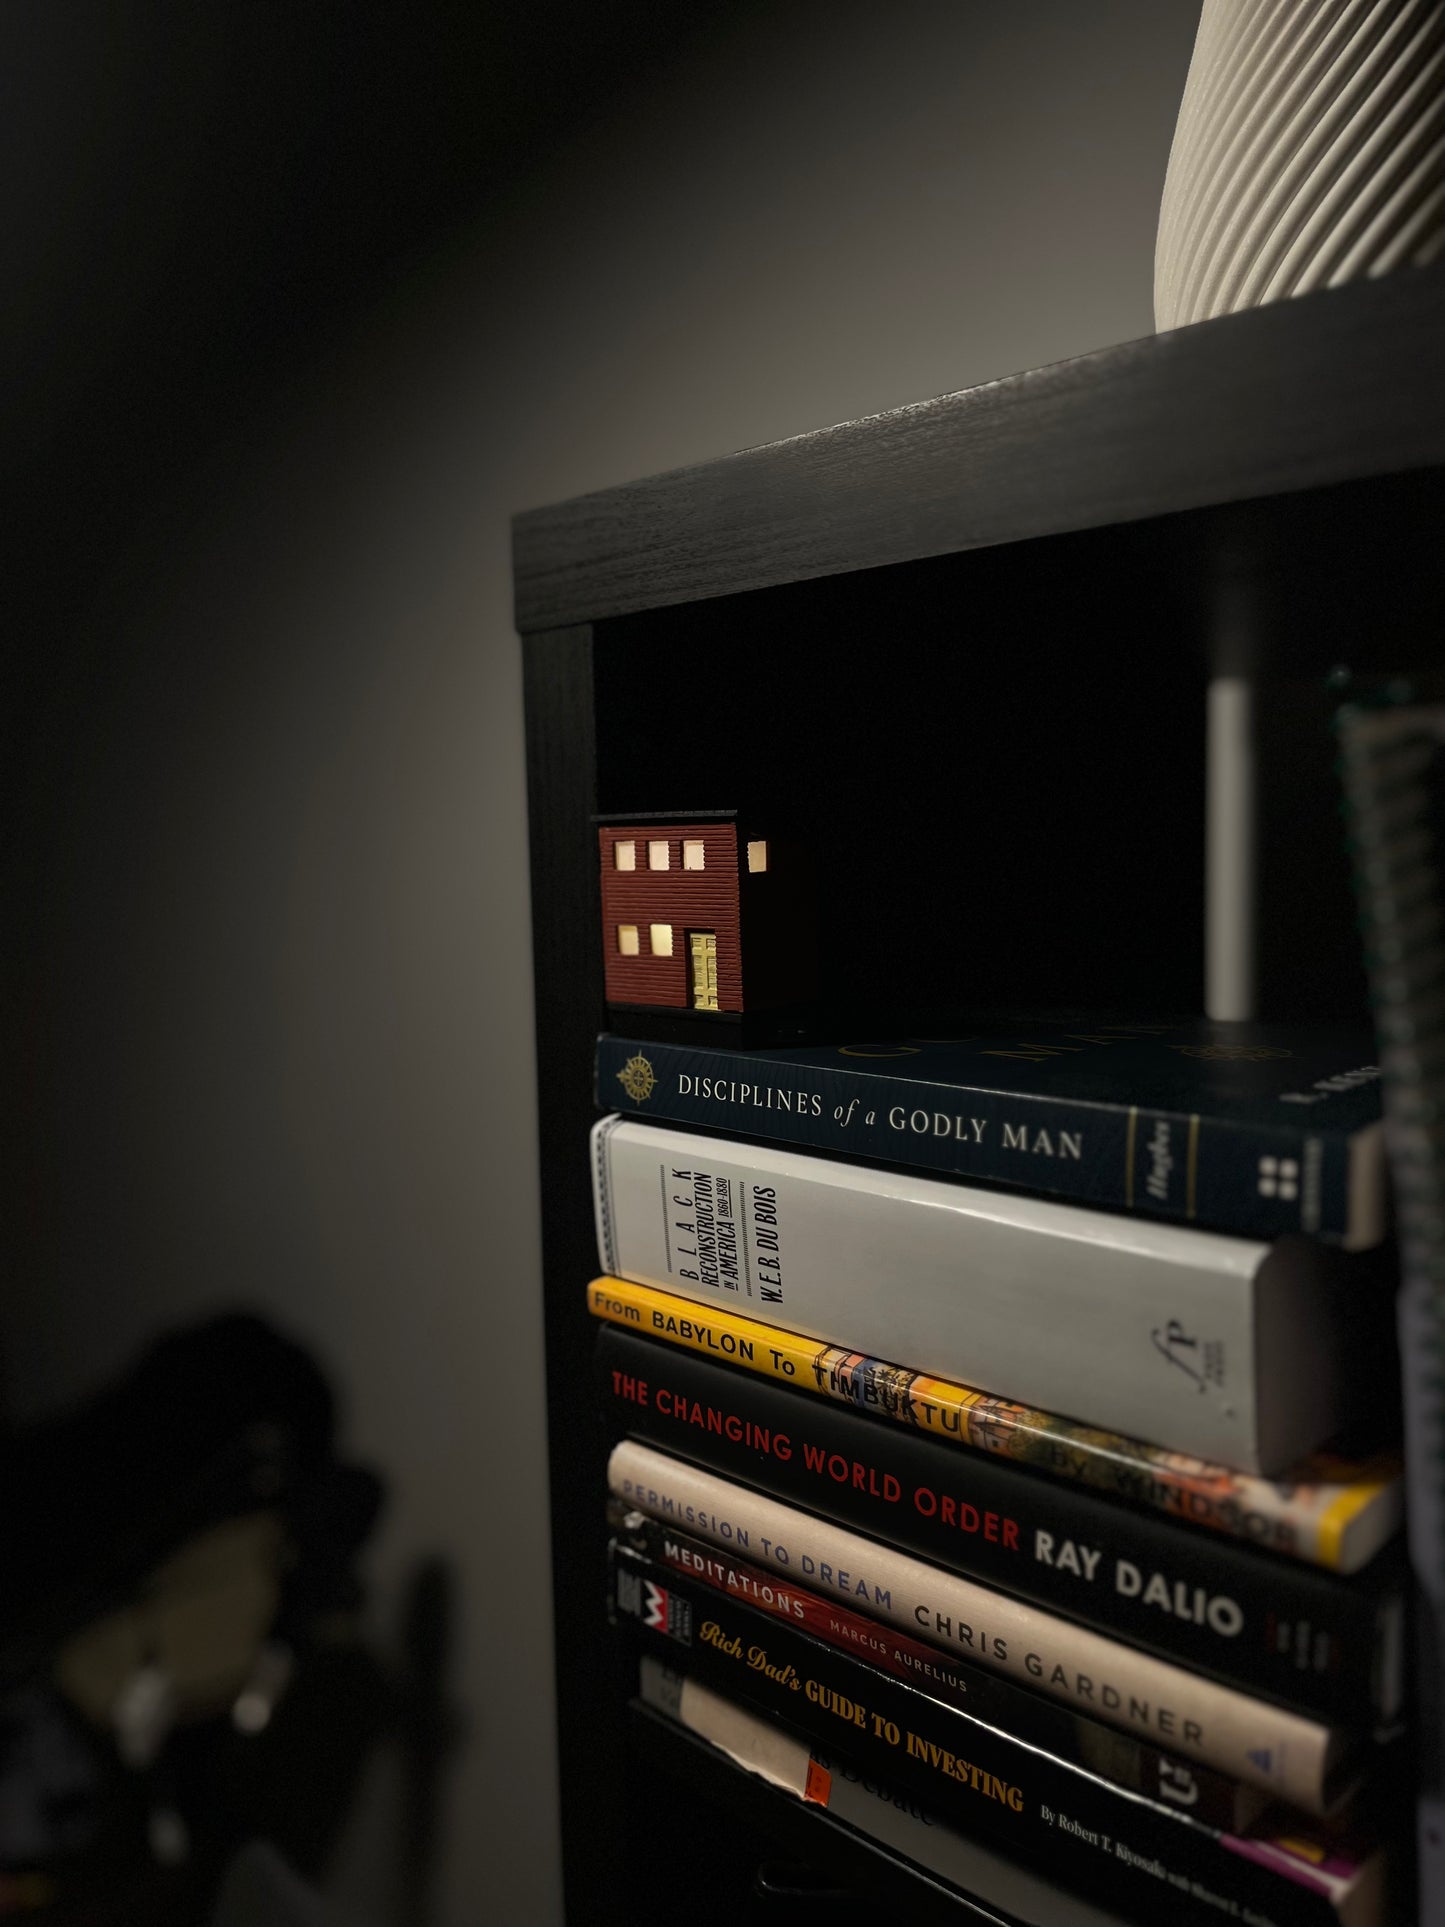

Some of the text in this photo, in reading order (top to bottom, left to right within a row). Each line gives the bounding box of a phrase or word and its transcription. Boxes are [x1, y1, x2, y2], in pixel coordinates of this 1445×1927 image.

[678, 1073, 1083, 1161] DISCIPLINES of a GODLY MAN
[693, 1171, 720, 1288] RECONSTRUCTION
[715, 1177, 739, 1290] IN AMERICA 1860-1880
[752, 1185, 778, 1226] BOIS
[755, 1227, 780, 1252] DU
[593, 1291, 641, 1323] From
[651, 1311, 754, 1361] BABYLON
[769, 1349, 796, 1376] To
[811, 1363, 960, 1433] TIMBUKTU
[610, 1369, 1245, 1638] THE CHANGING WORLD ORDER RAY DALIO
[623, 1479, 1205, 1745] PERMISSION TO DREAM CHRIS GARDNER
[663, 1540, 968, 1694] MEDITATIONS MARCUS AURELIUS
[699, 1620, 745, 1660] Rich
[746, 1645, 802, 1692] Dad's
[805, 1679, 867, 1729] GUIDE
[869, 1711, 901, 1747] TO
[905, 1731, 1026, 1814] INVESTING
[1040, 1804, 1055, 1826] By
[1058, 1814, 1099, 1847] Robert
[1100, 1834, 1113, 1853] T.
